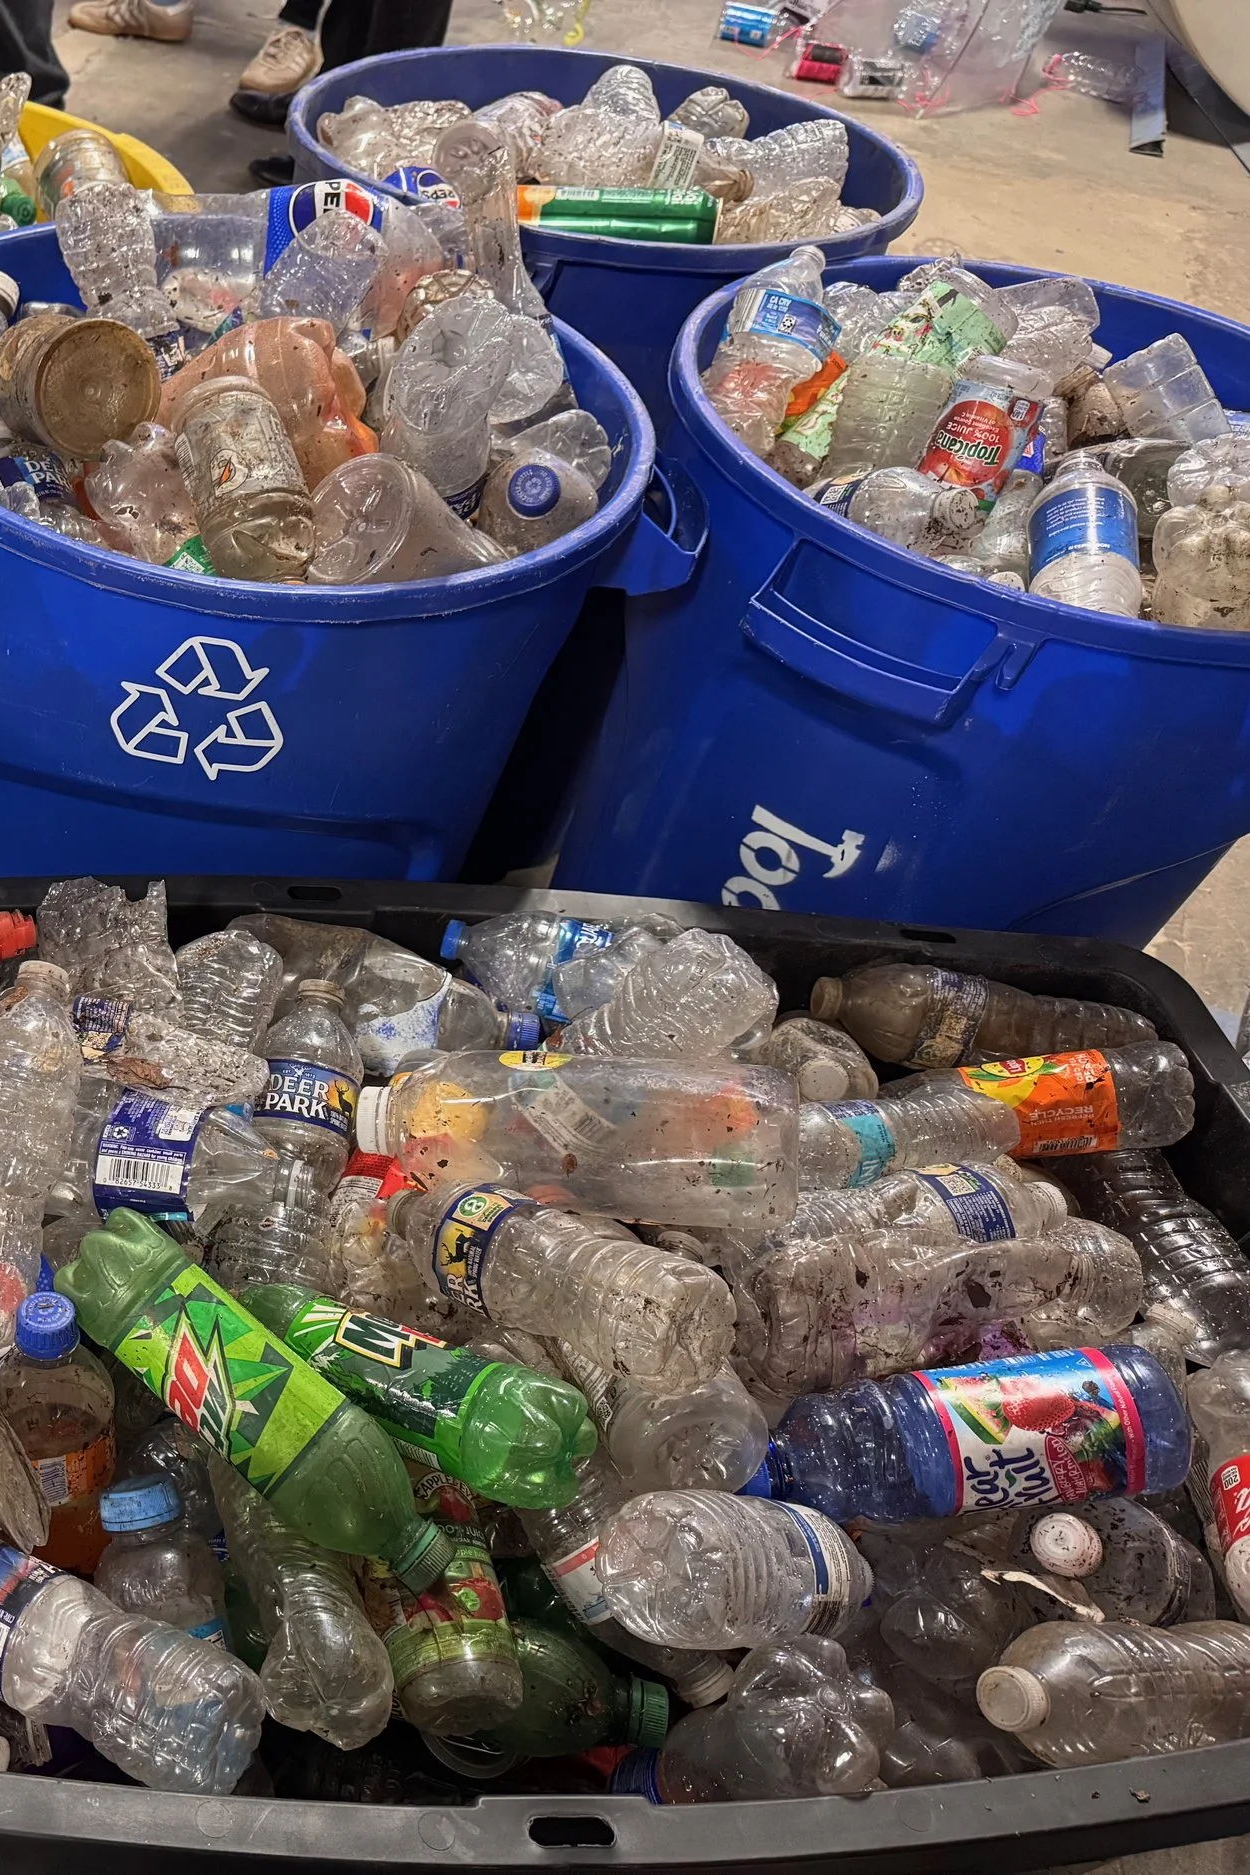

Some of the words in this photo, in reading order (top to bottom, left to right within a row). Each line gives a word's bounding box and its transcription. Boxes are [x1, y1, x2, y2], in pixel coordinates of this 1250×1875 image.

[946, 421, 973, 435] JUICE
[975, 430, 1000, 443] 100%
[935, 430, 1002, 466] Tropicana
[269, 1071, 330, 1100] DEER
[264, 1093, 329, 1121] PARK
[1030, 1105, 1093, 1121] RECYCLE
[1030, 1117, 1054, 1125] THEN
[1056, 1113, 1094, 1122] REFRESH
[1224, 1474, 1238, 1489] 200
